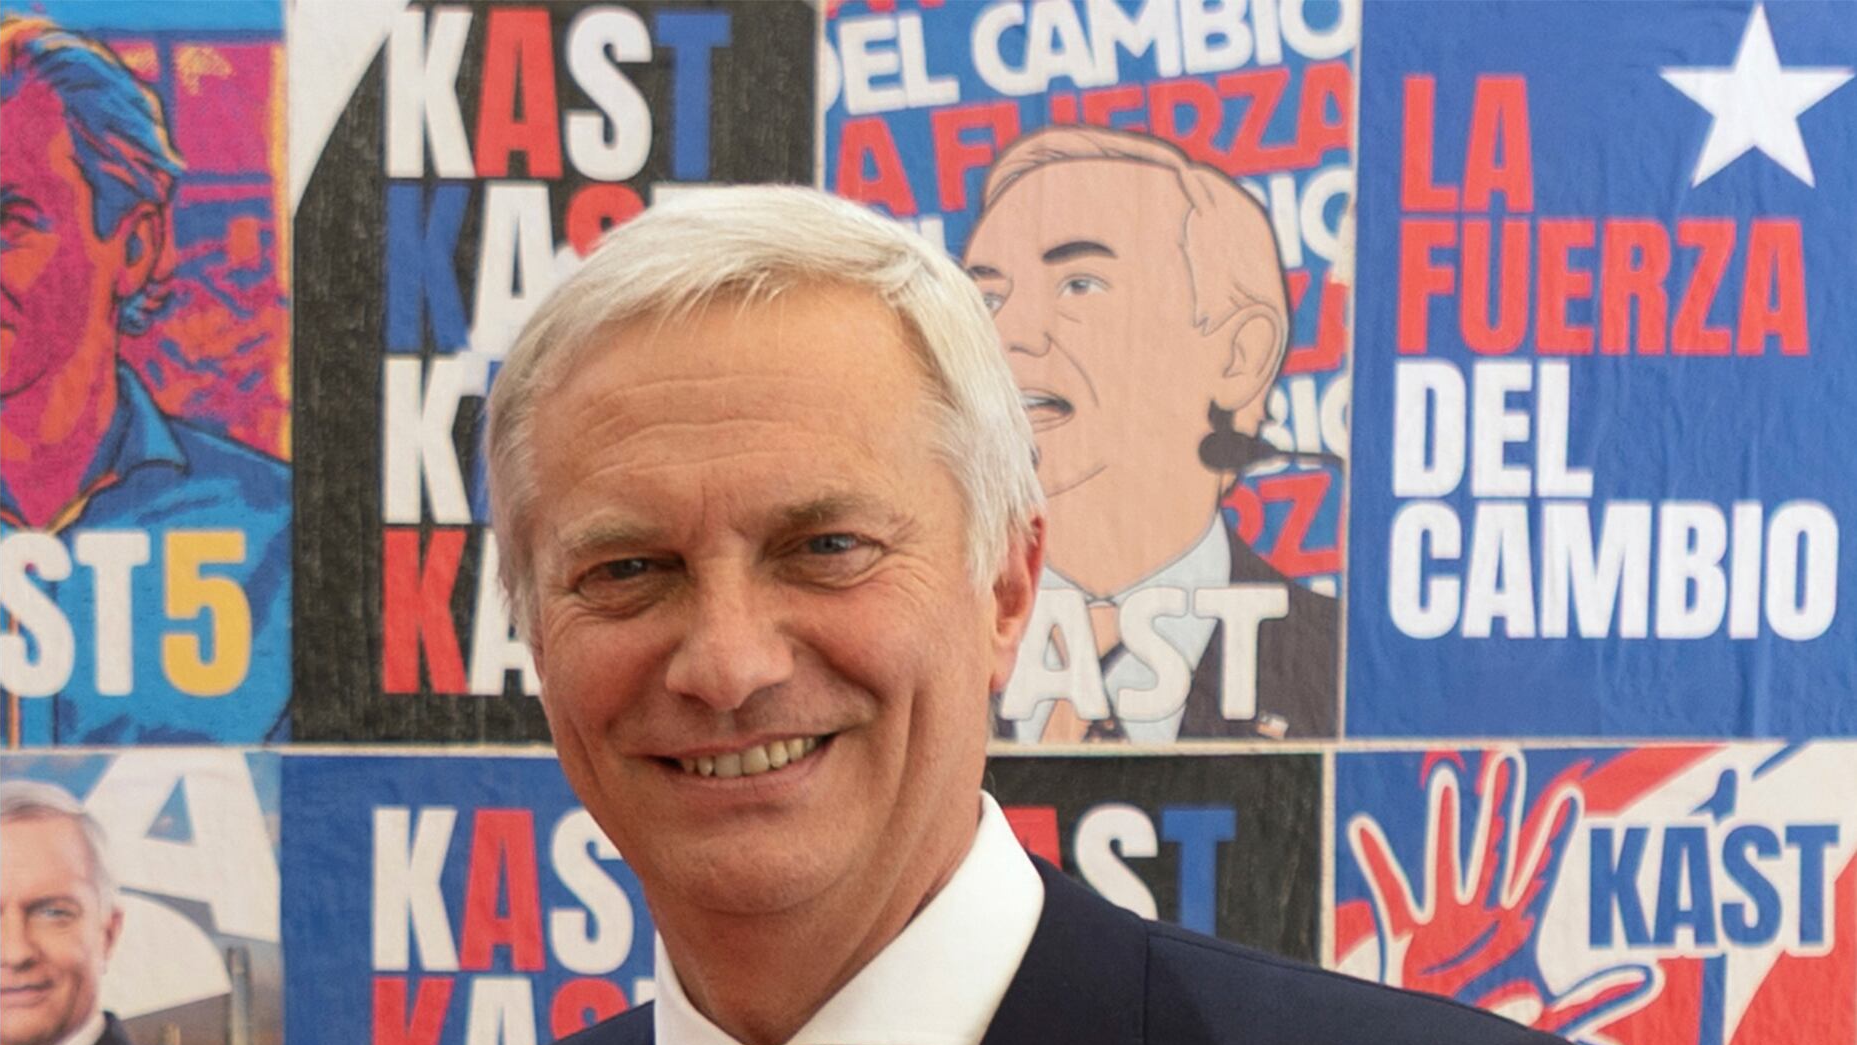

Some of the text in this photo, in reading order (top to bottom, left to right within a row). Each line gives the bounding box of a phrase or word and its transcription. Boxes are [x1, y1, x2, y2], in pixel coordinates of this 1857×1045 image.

[385, 8, 733, 180] KAST
[971, 0, 1359, 97] CAMBIO
[930, 61, 1354, 212] FRZA
[1400, 74, 1534, 212] LA
[1396, 218, 1810, 356] FUERZA
[1393, 359, 1594, 499] DEL
[1388, 500, 1840, 641] CAMBIO
[1589, 824, 1839, 947] KAST
